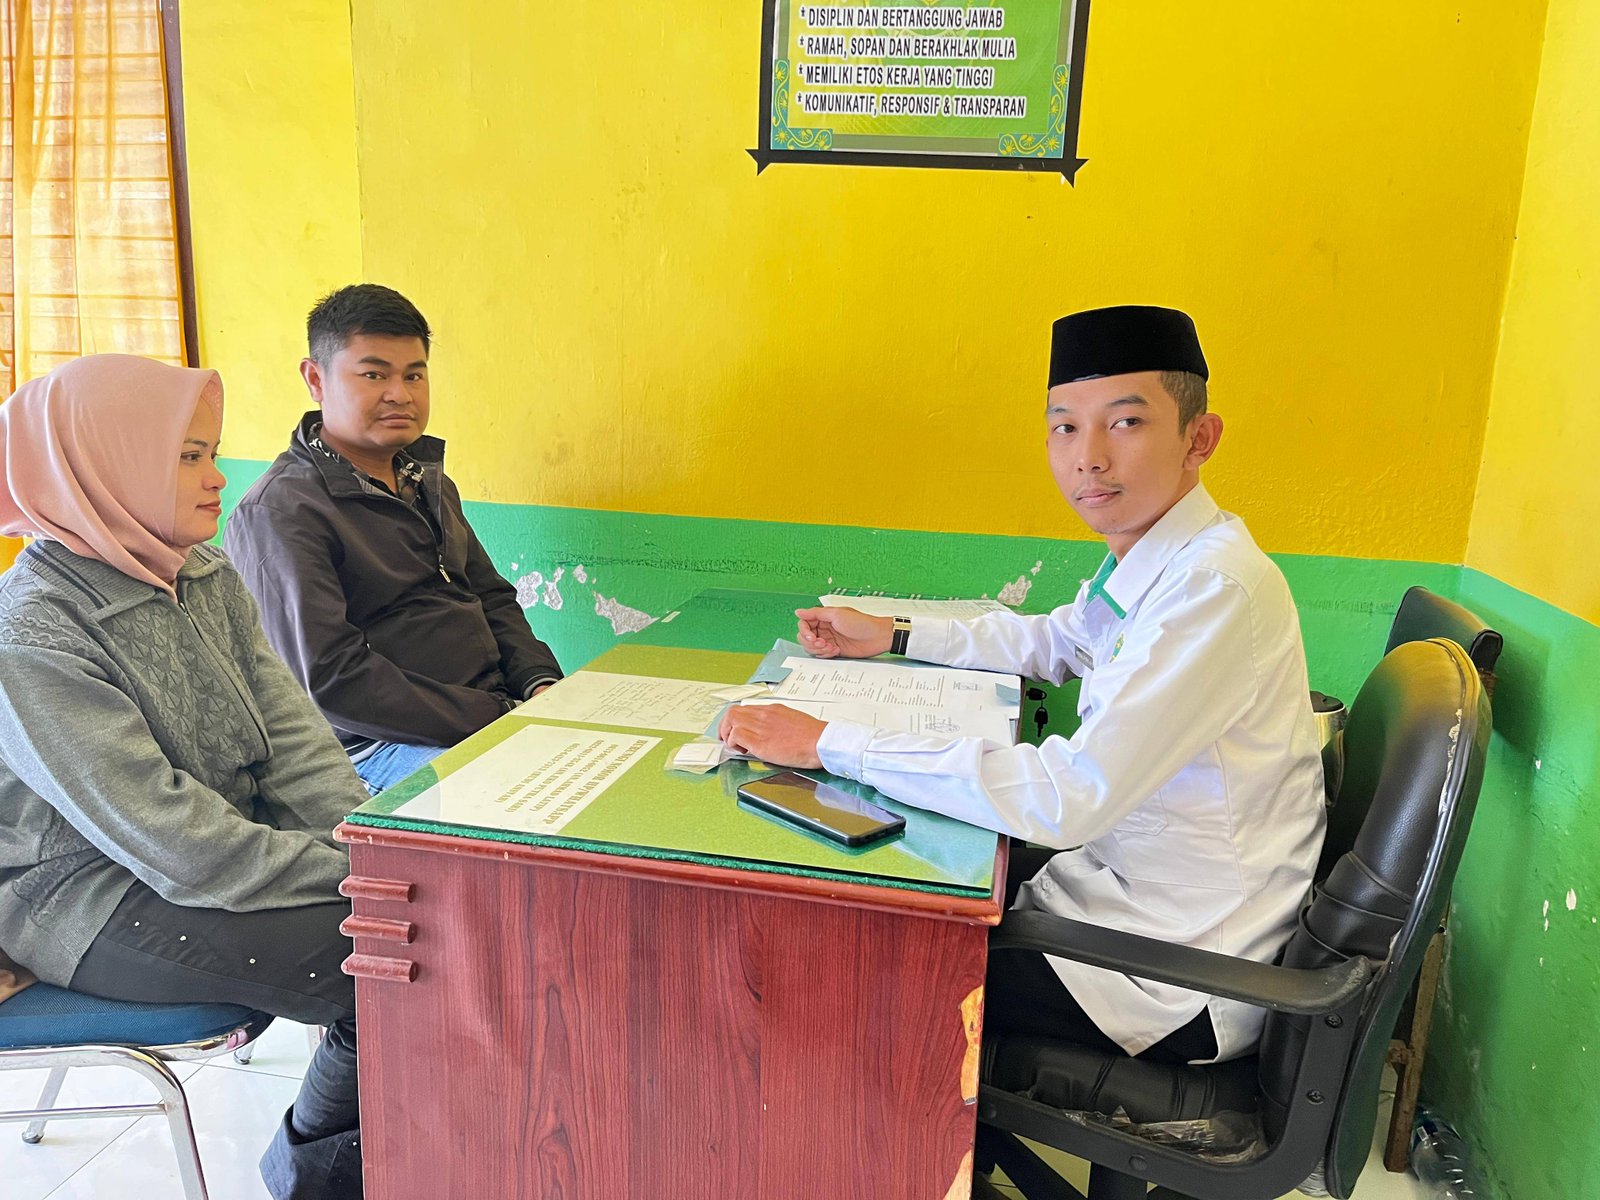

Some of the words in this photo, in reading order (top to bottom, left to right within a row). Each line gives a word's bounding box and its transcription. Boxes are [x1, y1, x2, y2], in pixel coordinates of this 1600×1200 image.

[809, 8, 853, 27] DISIPLIN
[858, 9, 878, 27] DAN
[883, 9, 962, 27] BERTANGGUNG
[966, 10, 1003, 28] JAWAB
[807, 37, 847, 58] RAMAH,
[851, 38, 885, 56] SOPAN
[889, 38, 910, 56] DAN
[914, 39, 978, 57] BERAKHLAK
[981, 40, 1015, 58] MULIA
[806, 66, 853, 84] MEMILIKI
[857, 67, 883, 84] ETOS
[887, 67, 920, 85] KERJA
[924, 68, 952, 86] YANG
[956, 68, 993, 87] TINGGI
[805, 94, 877, 116] KOMUNIKATIF,
[881, 96, 939, 114] RESPONSIF
[944, 98, 950, 115] &
[954, 97, 1025, 116] TRANSPARAN
